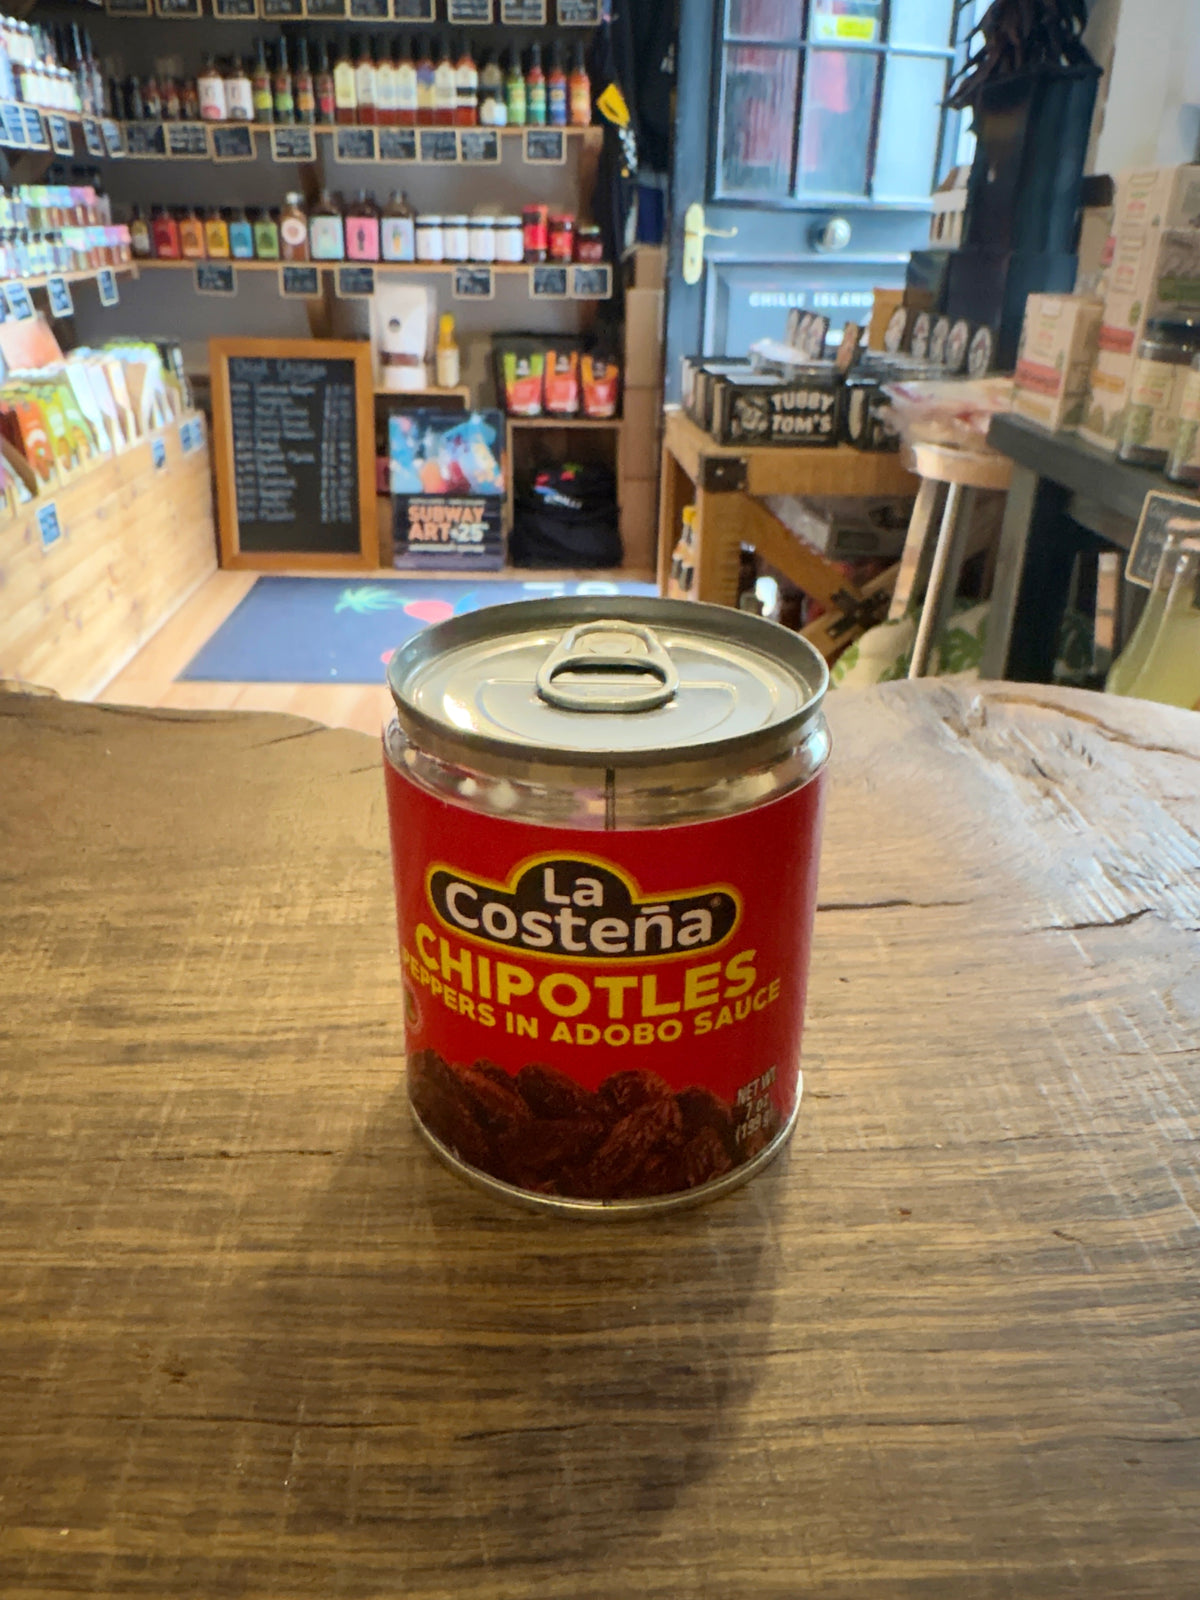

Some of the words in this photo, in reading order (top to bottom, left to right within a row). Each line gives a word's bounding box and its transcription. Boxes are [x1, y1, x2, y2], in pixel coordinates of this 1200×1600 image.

[771, 390, 834, 412] TUBBY
[772, 413, 832, 433] TOM'S
[408, 505, 485, 523] SUBWAY
[408, 522, 452, 541] ART
[543, 867, 604, 908] La
[445, 882, 713, 953] Costeña
[415, 922, 757, 1019] CHIPOTLES
[400, 944, 497, 1028] PEPPERS
[506, 1011, 539, 1039] IN
[551, 1019, 683, 1046] ADOBO
[693, 977, 781, 1036] SAUCE
[737, 1077, 761, 1107] NET
